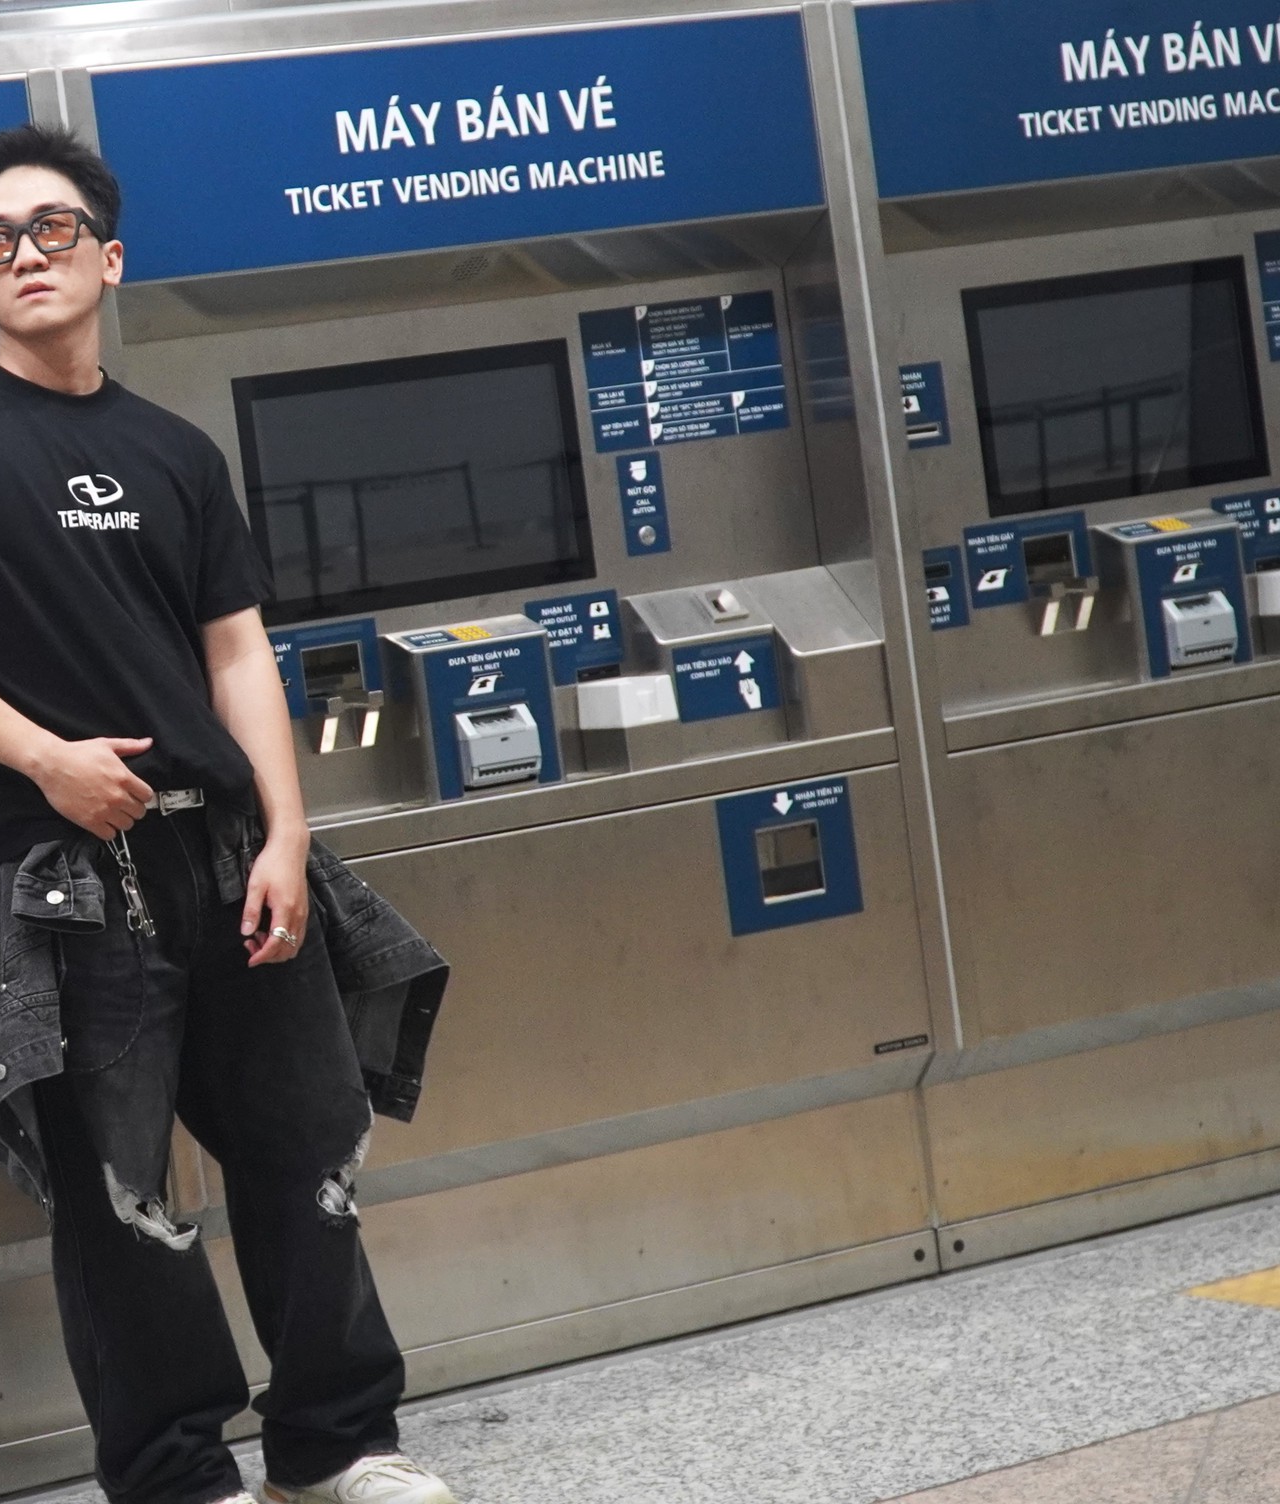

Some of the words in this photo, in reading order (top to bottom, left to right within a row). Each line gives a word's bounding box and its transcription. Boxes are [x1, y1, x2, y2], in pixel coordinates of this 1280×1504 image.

[1060, 27, 1153, 84] MÁY
[1161, 18, 1241, 74] BÁN
[1249, 22, 1280, 65] V
[334, 96, 443, 155] MÁY
[455, 85, 549, 143] BÁN
[559, 74, 616, 133] VÉ
[1020, 106, 1102, 139] TICKET
[1110, 94, 1216, 129] VENDING
[286, 180, 385, 216] TICKET
[392, 166, 520, 205] VENDING
[528, 151, 664, 191] MACHINE
